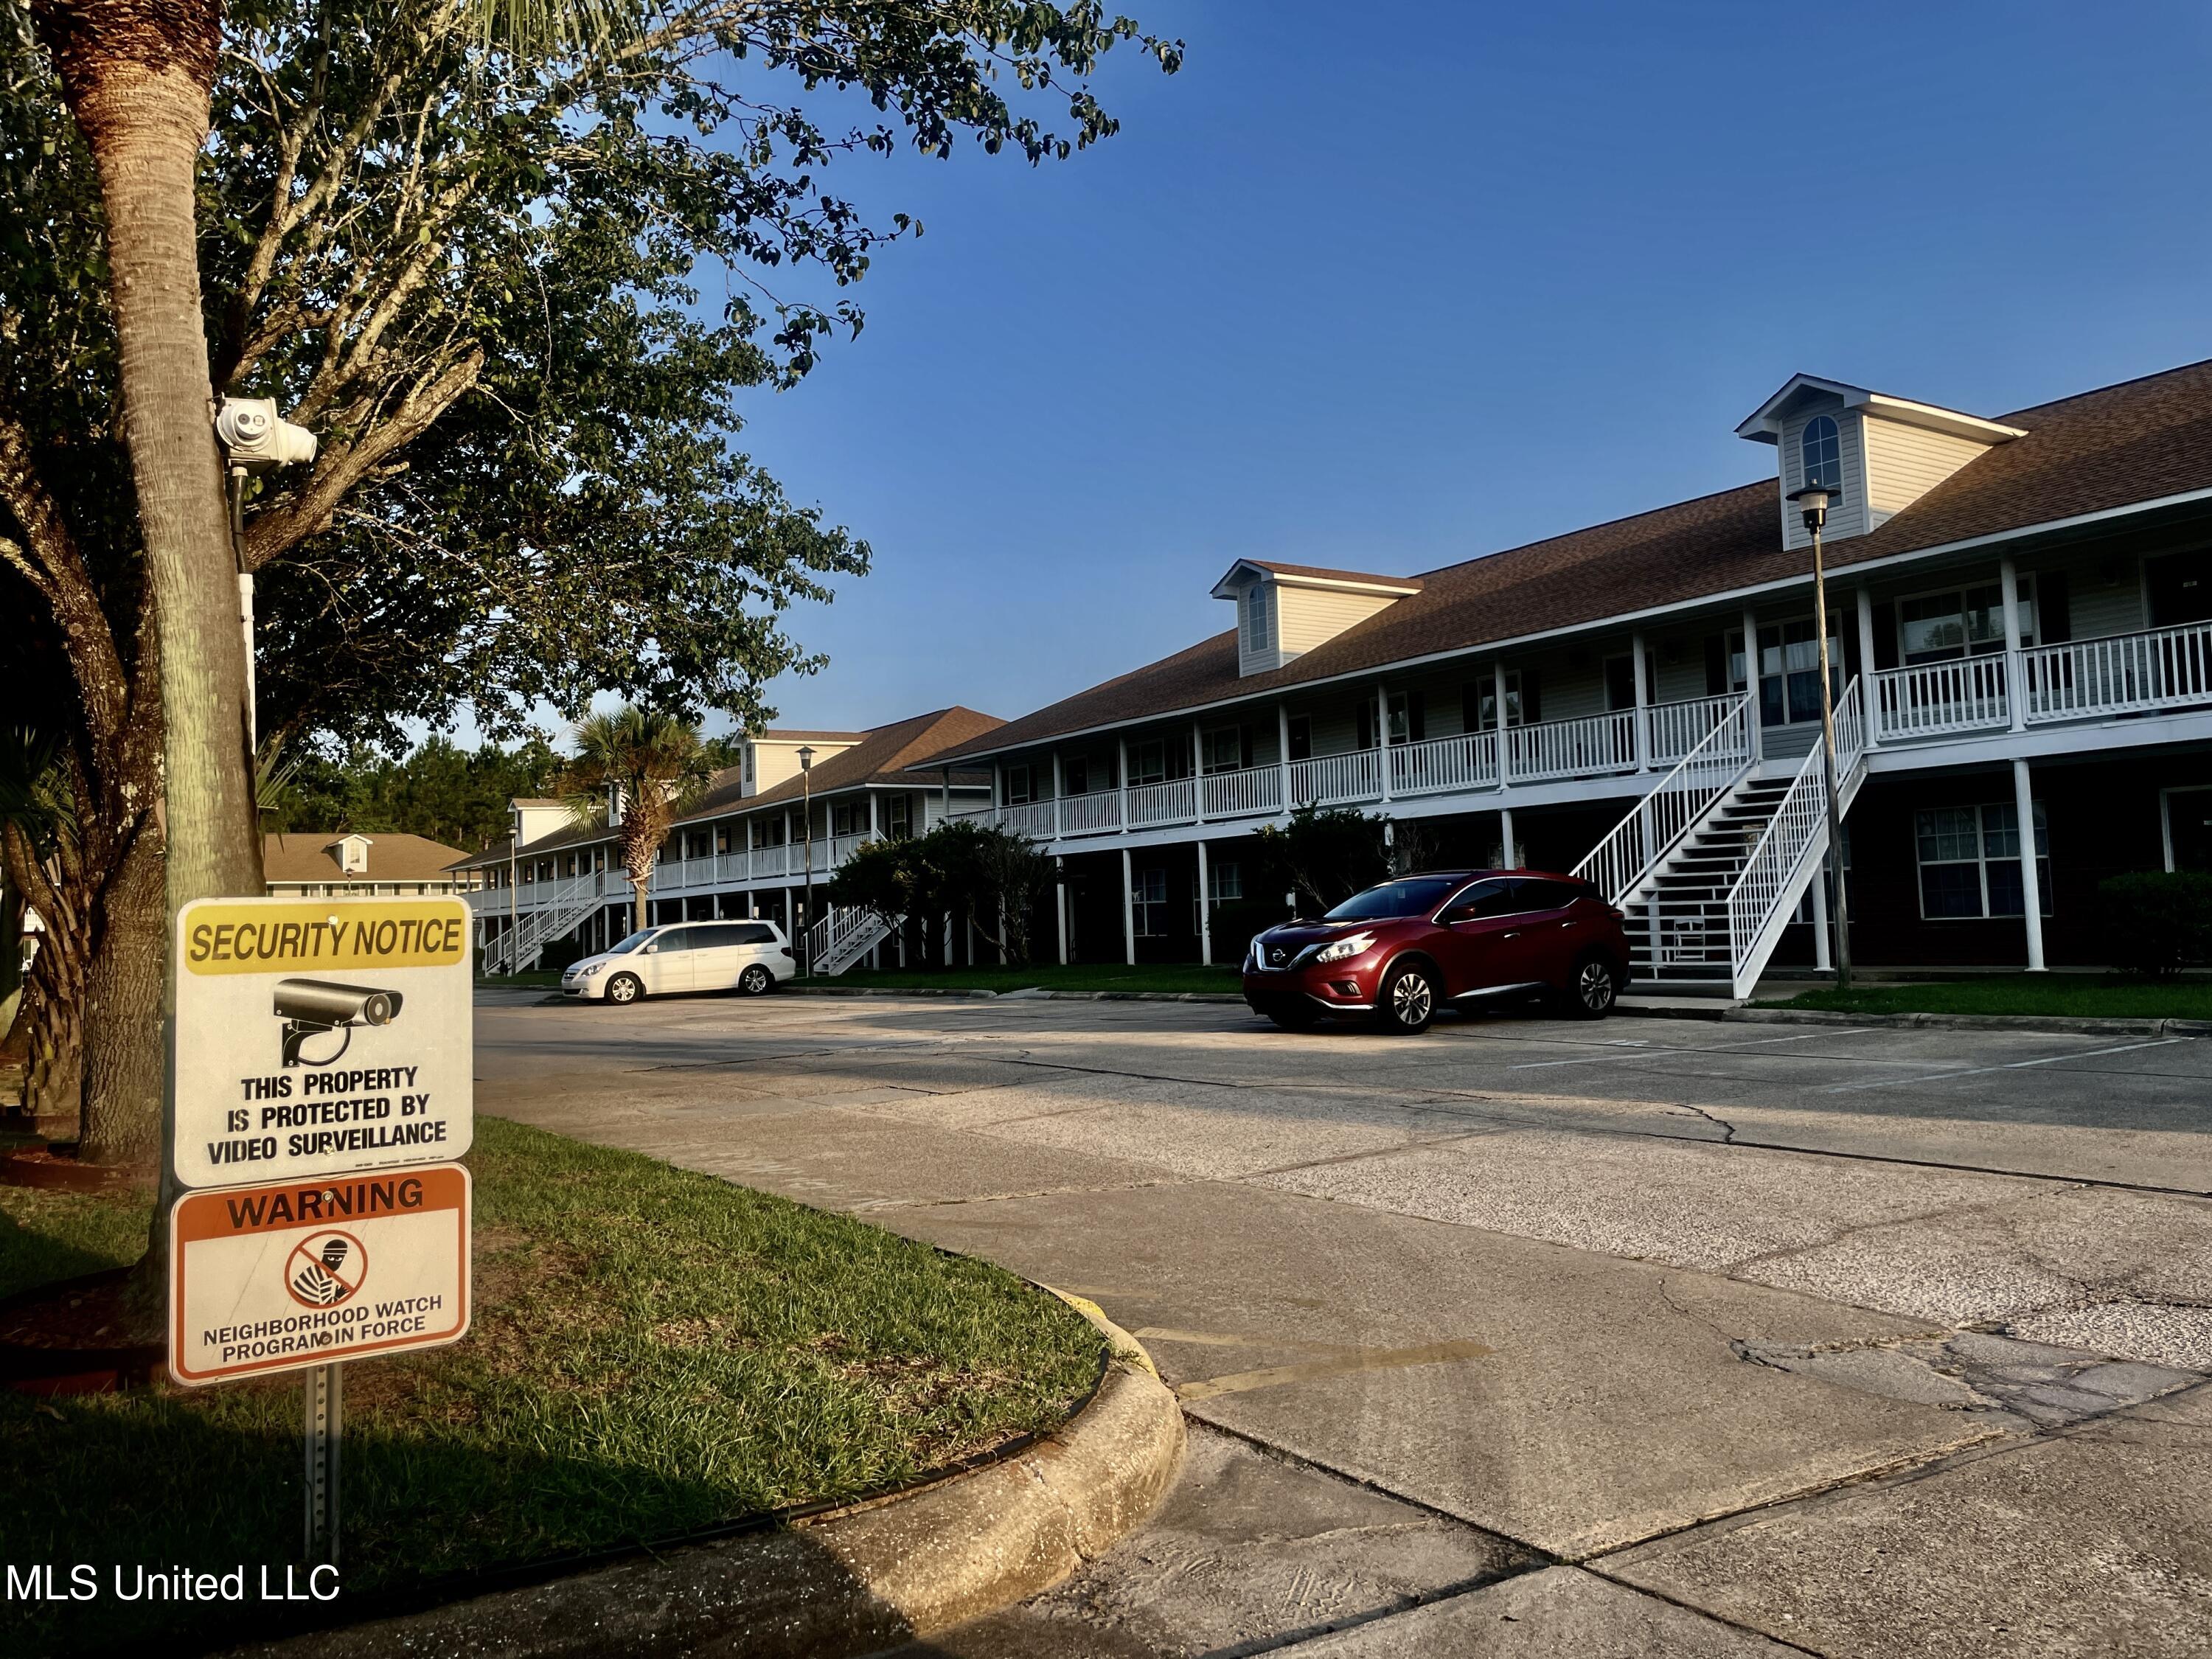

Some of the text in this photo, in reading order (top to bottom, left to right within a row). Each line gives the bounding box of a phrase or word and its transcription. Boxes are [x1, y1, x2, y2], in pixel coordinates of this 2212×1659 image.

[191, 919, 462, 961] SECURITY NOTICE
[241, 1066, 418, 1100] THIS PROPERTY
[227, 1094, 430, 1132] IS PROTECTED BY
[207, 1121, 447, 1165] VIDEO SURVEILLANCE
[226, 1178, 424, 1229] WARNING
[204, 1295, 442, 1346] NEIGHBORHOOD WATCH
[335, 1328, 354, 1343] IN
[361, 1315, 425, 1340] FORCE
